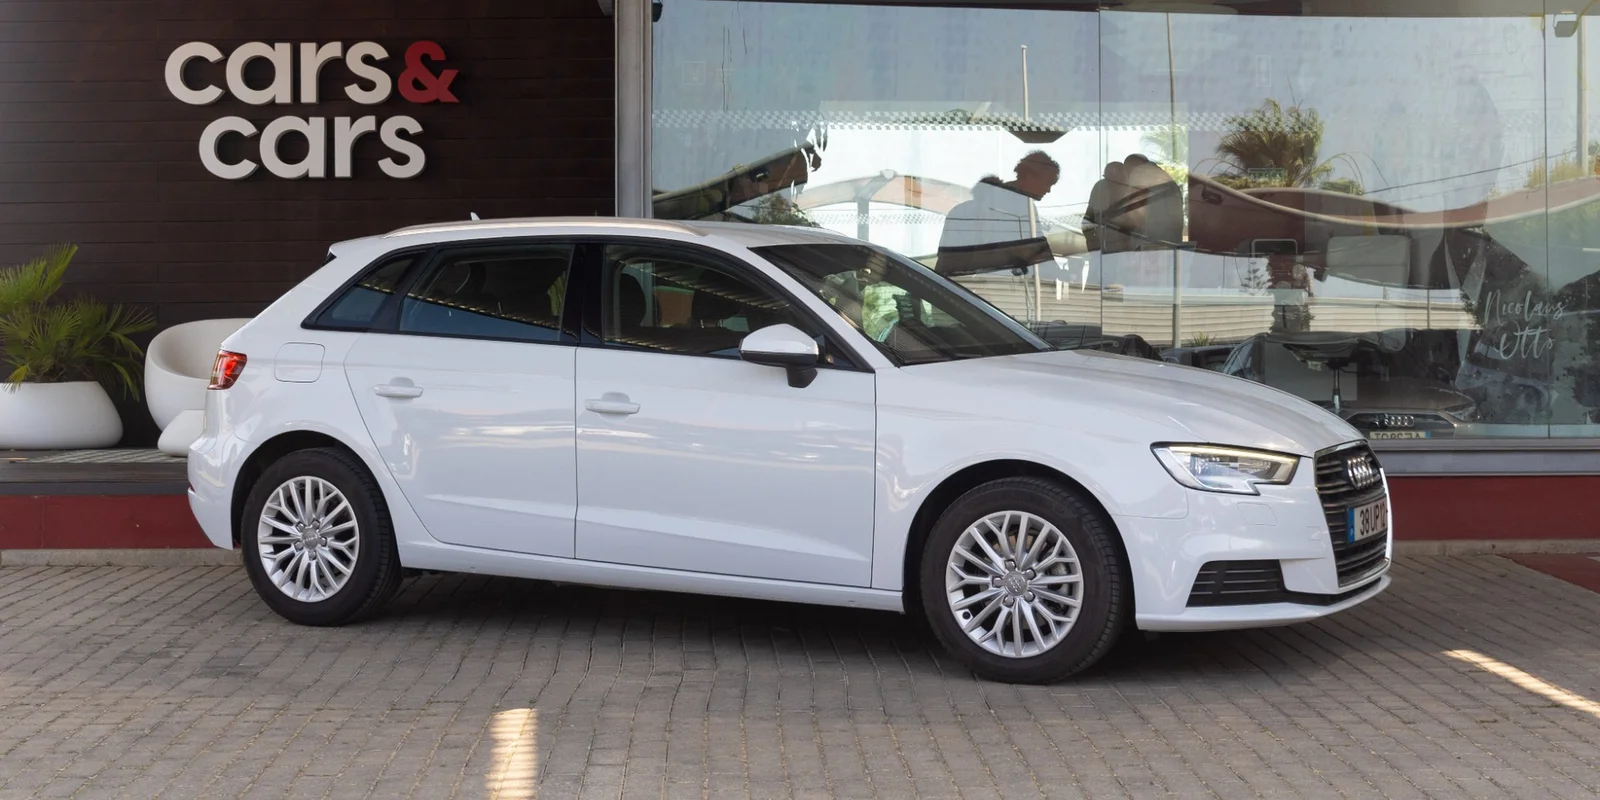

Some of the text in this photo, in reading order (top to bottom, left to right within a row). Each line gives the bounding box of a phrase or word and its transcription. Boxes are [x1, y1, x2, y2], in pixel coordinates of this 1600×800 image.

[165, 41, 458, 104] cars&
[199, 116, 425, 179] cars
[1497, 321, 1556, 359] Otto
